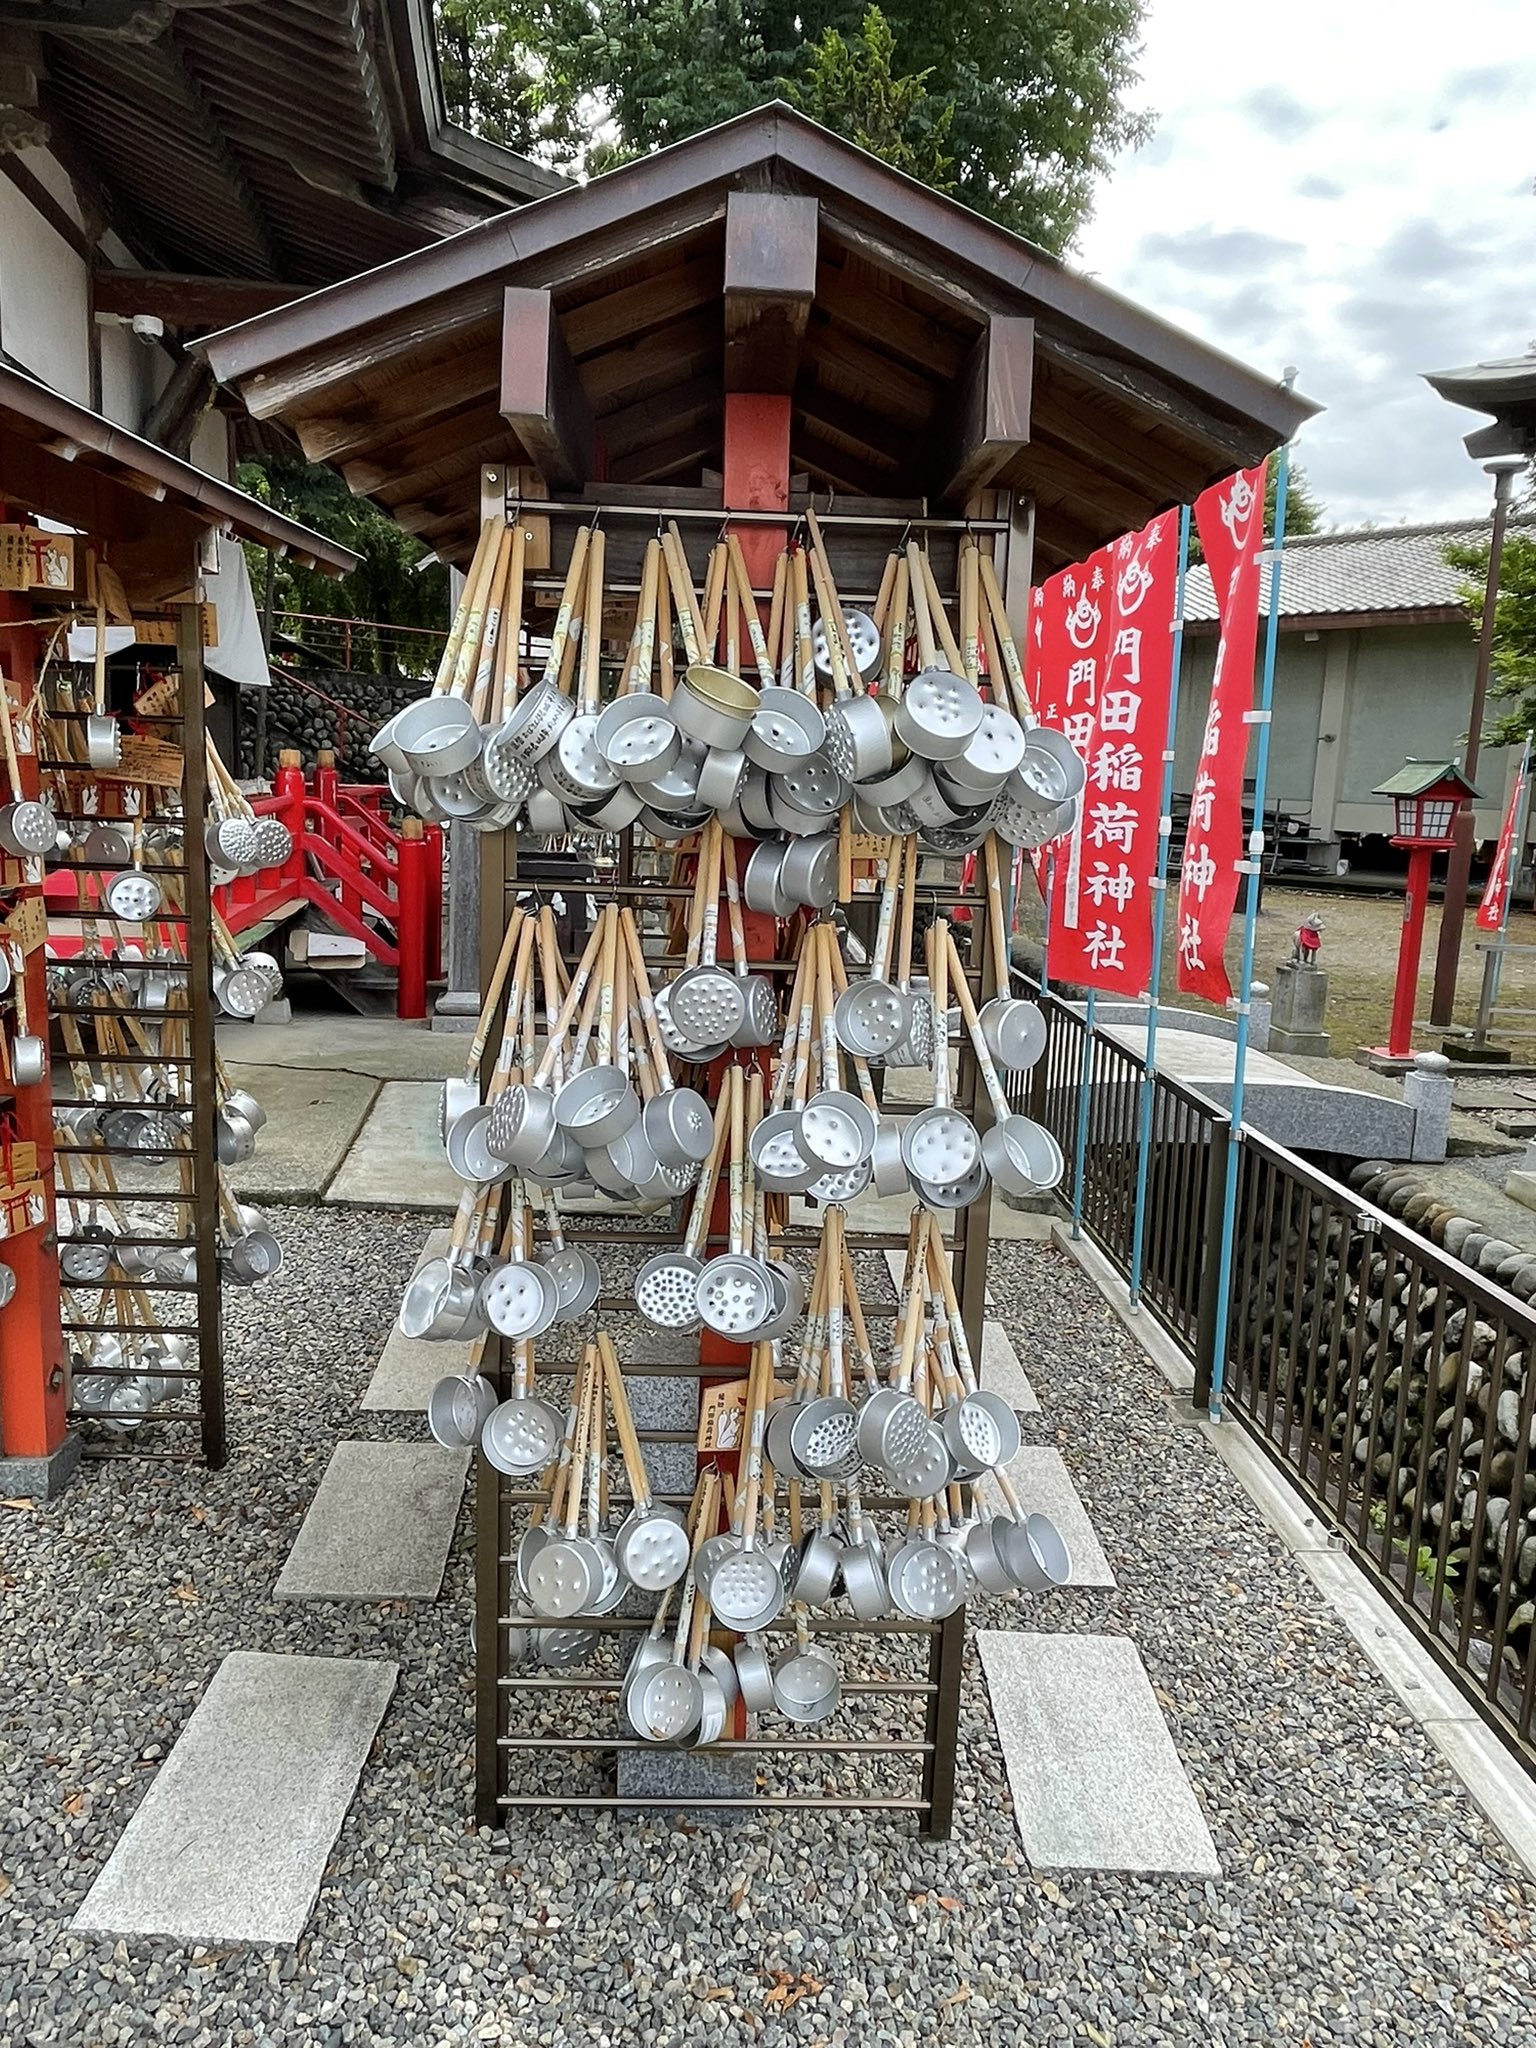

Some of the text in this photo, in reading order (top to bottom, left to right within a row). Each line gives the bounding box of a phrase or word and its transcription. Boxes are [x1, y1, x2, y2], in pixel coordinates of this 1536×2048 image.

[1083, 626, 1144, 971] 門田稲荷神社
[1179, 566, 1241, 972] 稲荷神社
